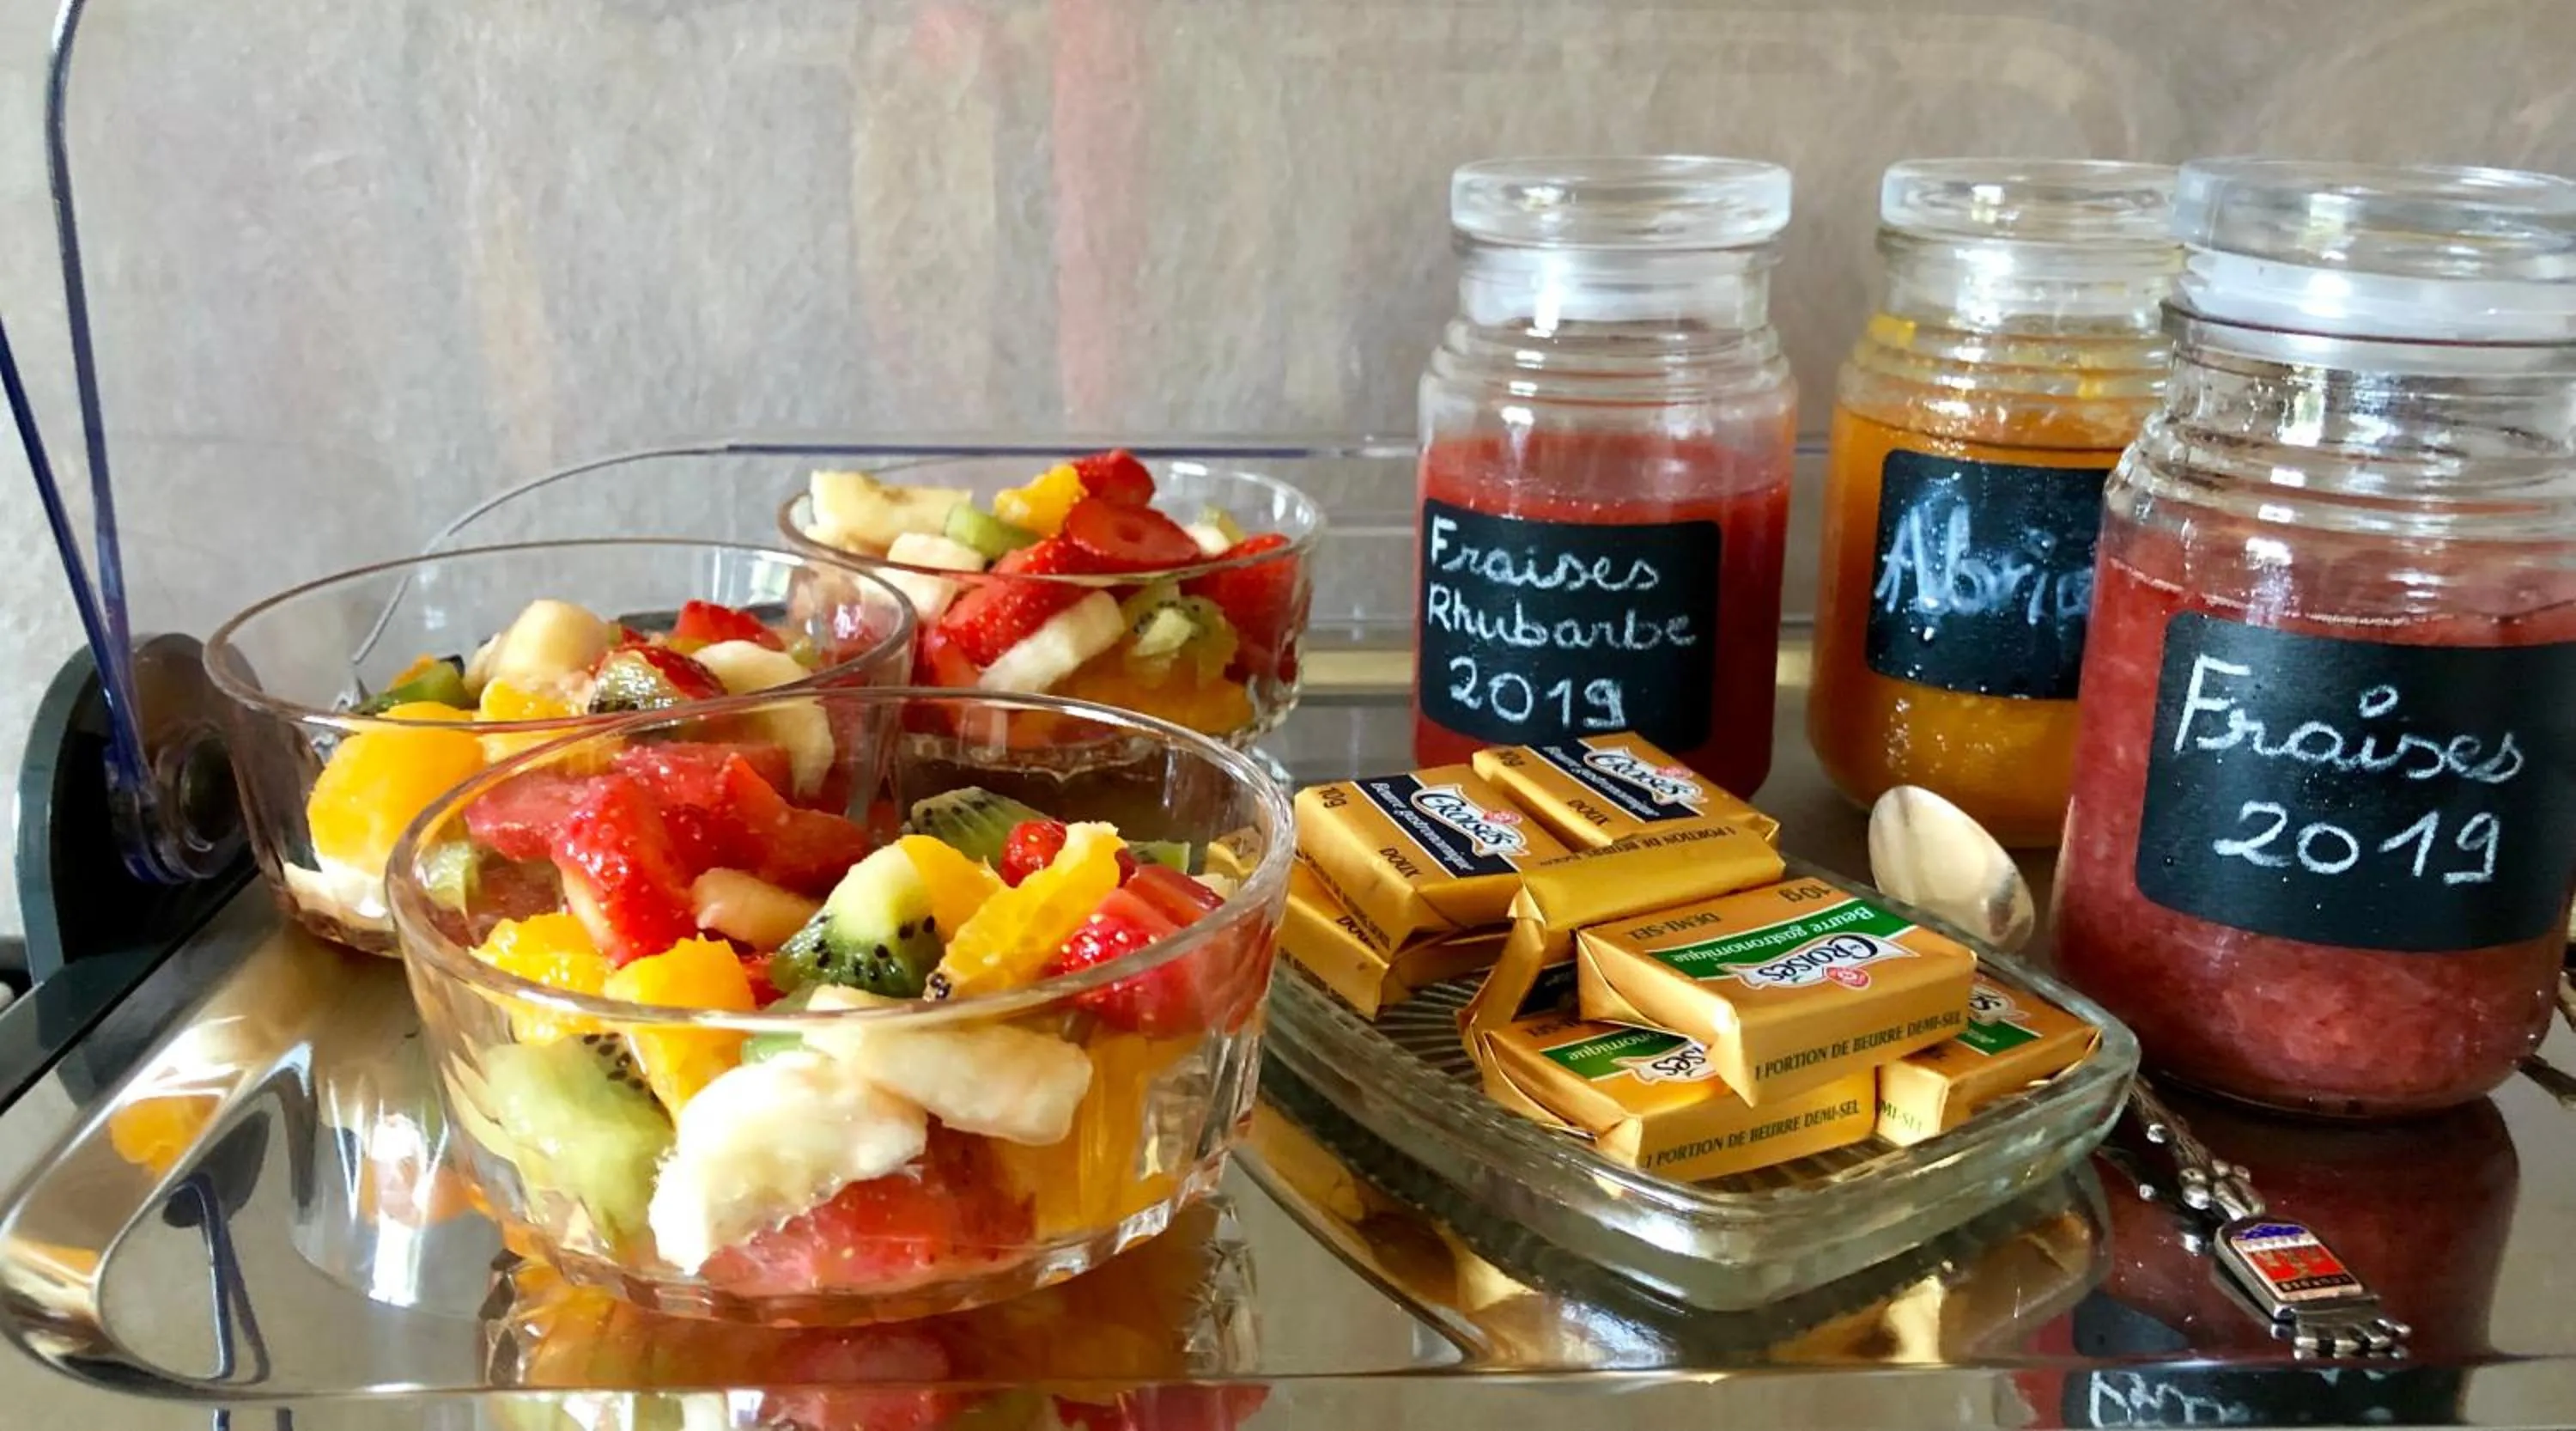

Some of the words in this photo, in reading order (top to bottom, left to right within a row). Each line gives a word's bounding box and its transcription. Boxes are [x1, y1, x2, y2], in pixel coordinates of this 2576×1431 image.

[1431, 514, 1660, 591] Fraises
[1428, 582, 1697, 650] Rhubarbe
[1449, 656, 1625, 728] 2019
[2173, 654, 2524, 783] Fraises
[1318, 786, 1347, 809] 10g
[1379, 847, 1422, 878] DOUX
[2212, 801, 2500, 886] 2019
[1629, 911, 1722, 941] DEMI-SEL
[1778, 884, 1833, 903] 10g
[1813, 906, 1875, 934] Beurre
[1674, 926, 1808, 963] gastronomique
[1765, 1045, 1827, 1079] PORTION
[1831, 1039, 1849, 1059] DE
[1852, 1026, 1904, 1054] BEURRE
[1906, 1010, 1963, 1038] DEMI-SEL
[1656, 1137, 1724, 1166] PORTION
[1728, 1133, 1747, 1149] DE
[1748, 1116, 1801, 1143] BEURRE
[1803, 1099, 1861, 1130] DEMI-SEL
